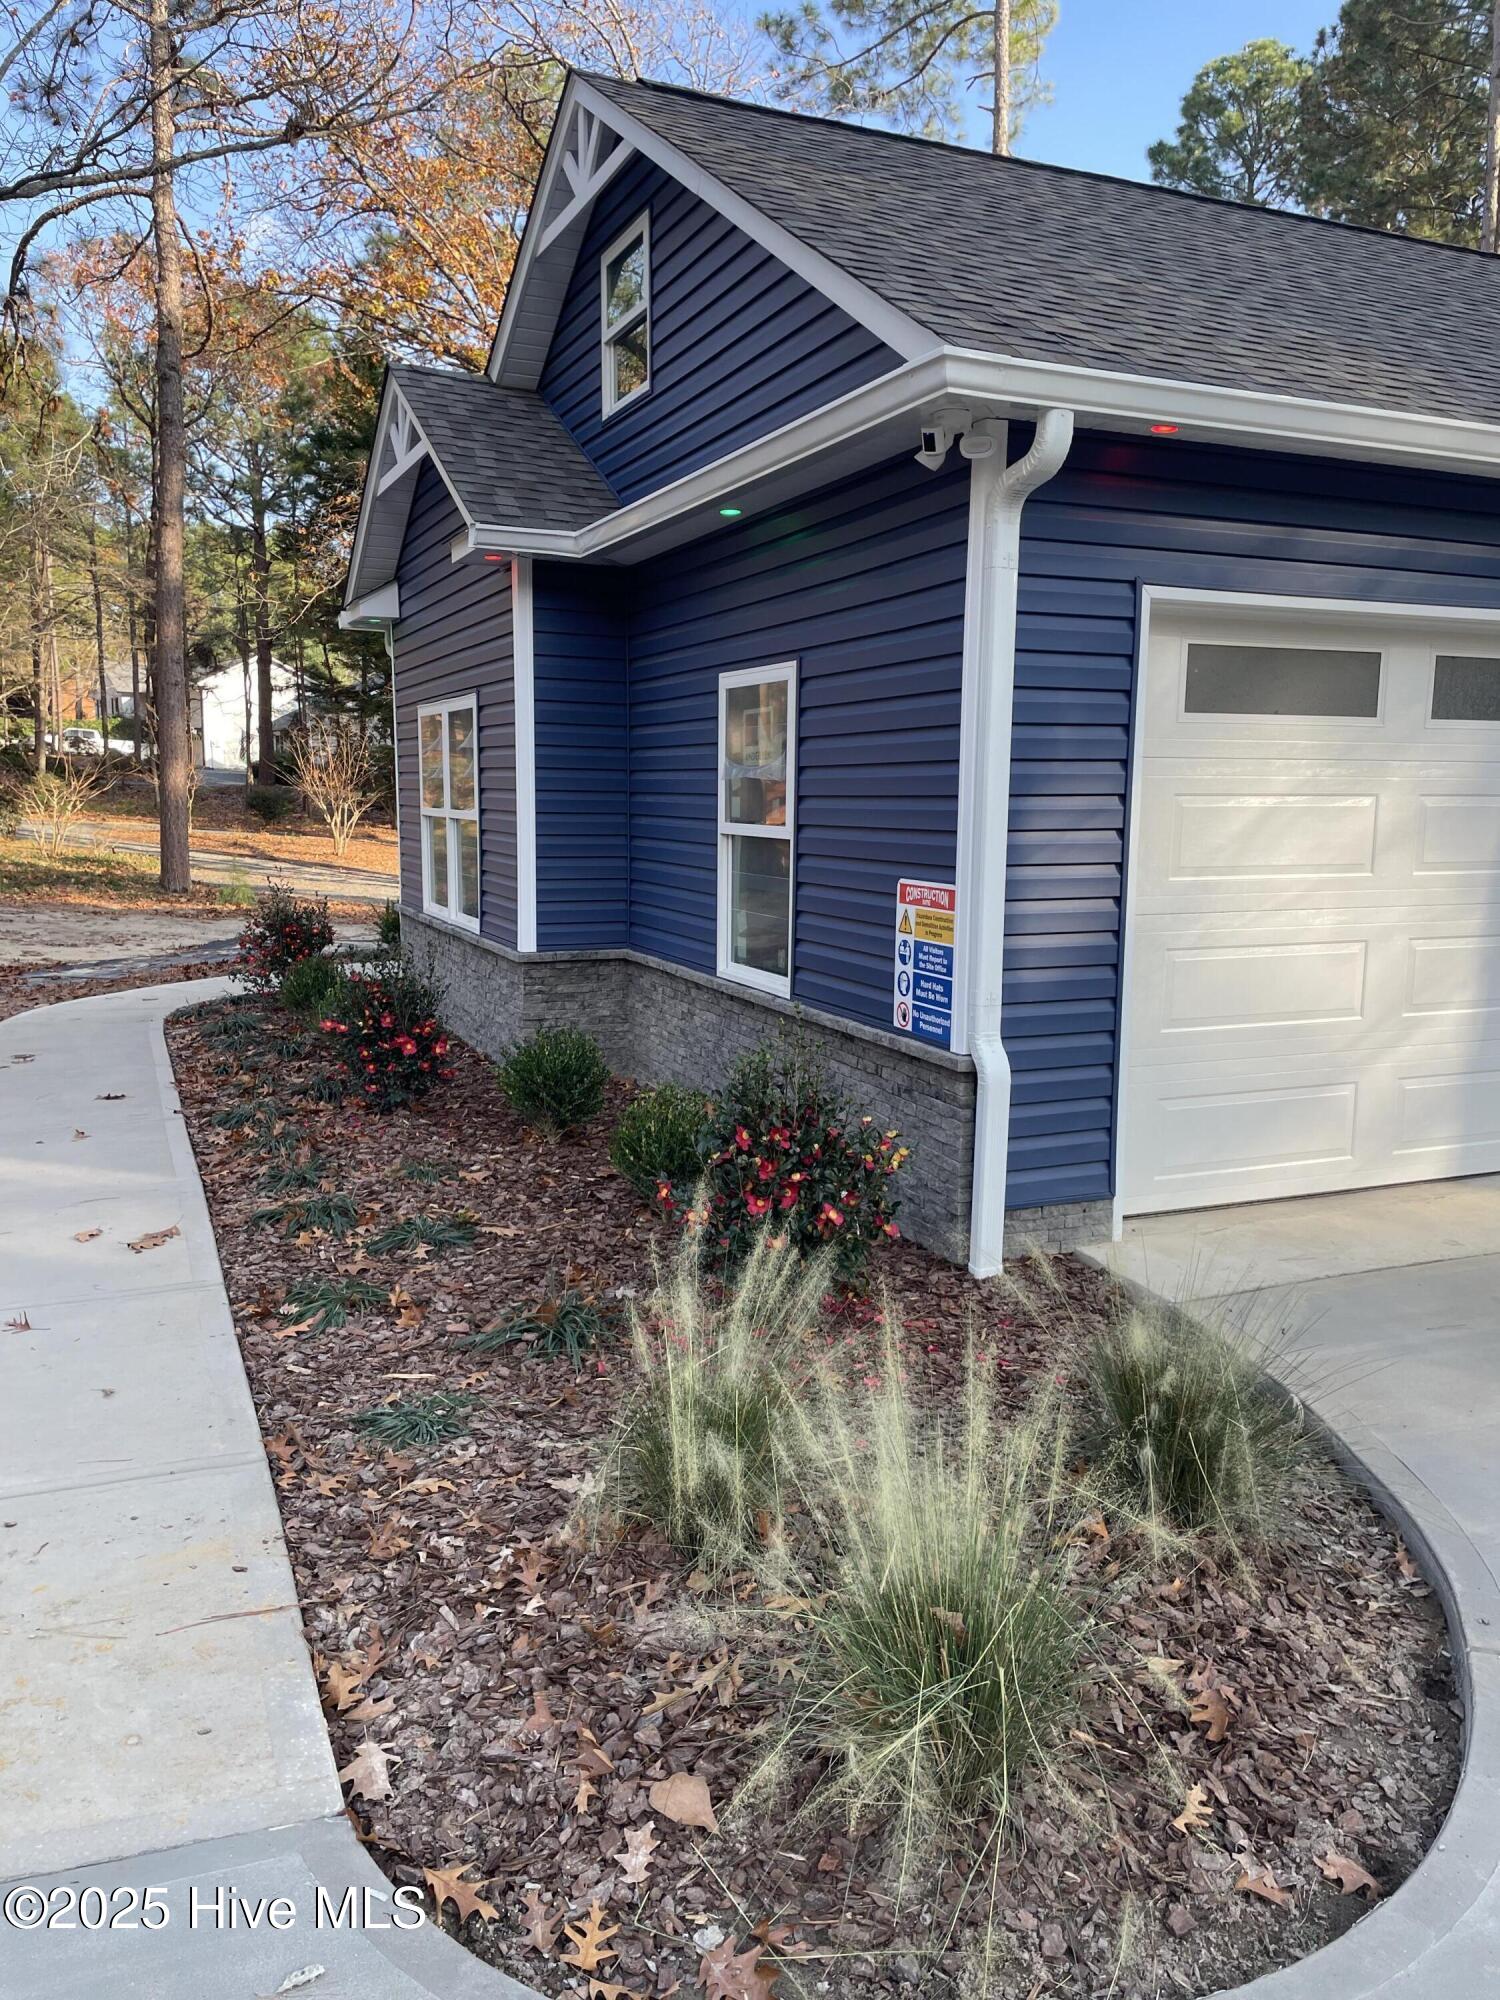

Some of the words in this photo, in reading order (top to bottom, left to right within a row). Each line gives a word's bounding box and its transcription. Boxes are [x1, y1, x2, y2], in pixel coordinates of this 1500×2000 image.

[906, 886, 949, 909] CONSTRUCTION
[929, 946, 944, 956] Visitors
[919, 952, 928, 960] Must
[929, 954, 942, 964] Report
[926, 962, 934, 970] Site
[934, 964, 947, 973] Office
[921, 979, 932, 989] Hard
[932, 982, 944, 992] Hats
[916, 988, 927, 998] Must
[928, 991, 935, 1000] Be
[936, 993, 948, 1003] Worn
[912, 1009, 919, 1018] No
[919, 1021, 943, 1035] Personnel
